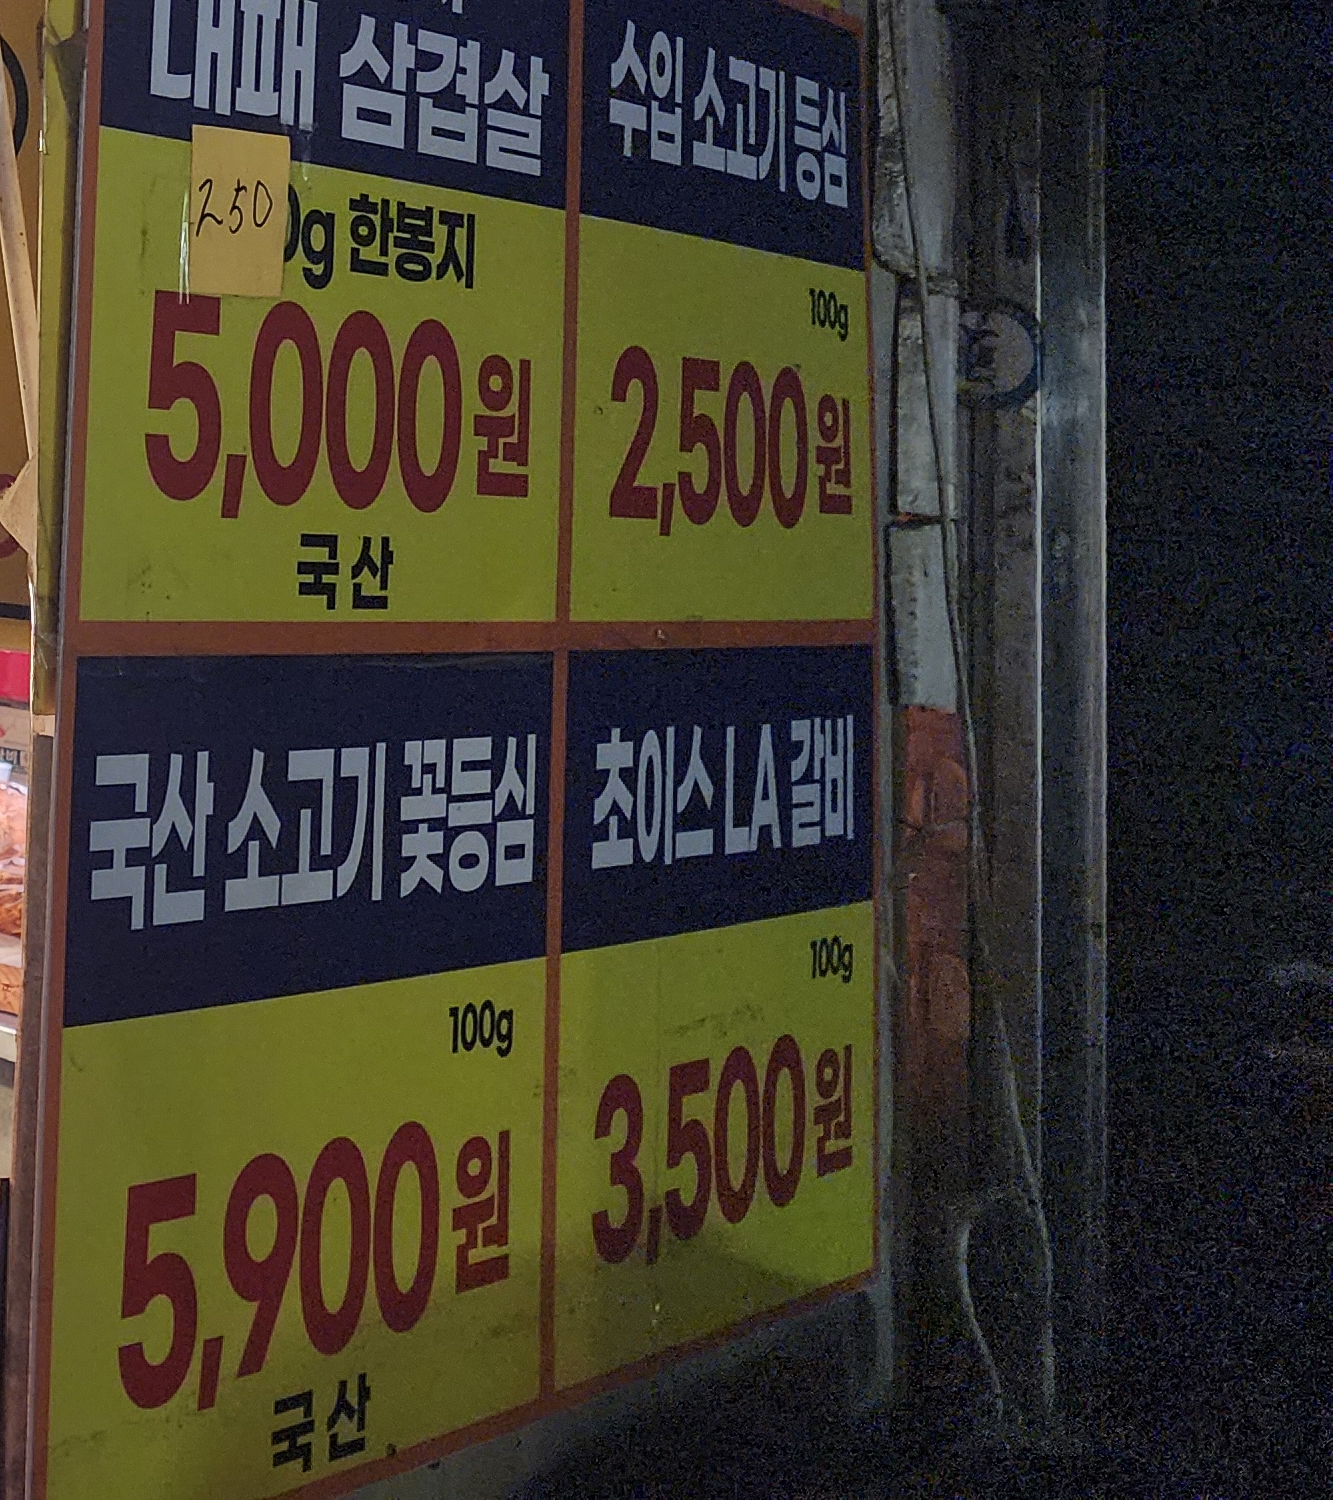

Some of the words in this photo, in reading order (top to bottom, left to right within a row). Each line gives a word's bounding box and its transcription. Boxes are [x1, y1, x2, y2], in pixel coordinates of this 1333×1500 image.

[339, 14, 549, 177] 삼겹살
[610, 20, 683, 166] 수입
[692, 47, 786, 192] 소고기
[792, 78, 848, 209] 등심
[196, 178, 273, 237] 250
[349, 193, 476, 289] 한봉지
[809, 289, 849, 341] 100g
[144, 291, 531, 519] 5,000원
[609, 344, 853, 537] 2,500원
[296, 533, 393, 610] 국산
[89, 748, 216, 930] 국산
[224, 742, 386, 912] 소고기
[399, 734, 536, 899] 꽃등심
[591, 725, 715, 871] 초이스
[724, 723, 781, 856] LA
[790, 715, 855, 848] 갈비
[449, 1000, 514, 1057] 100g
[810, 936, 853, 982] 100g
[592, 1034, 853, 1264] 3,500원
[118, 1120, 511, 1410] 5,900원
[272, 1373, 371, 1473] 국산
